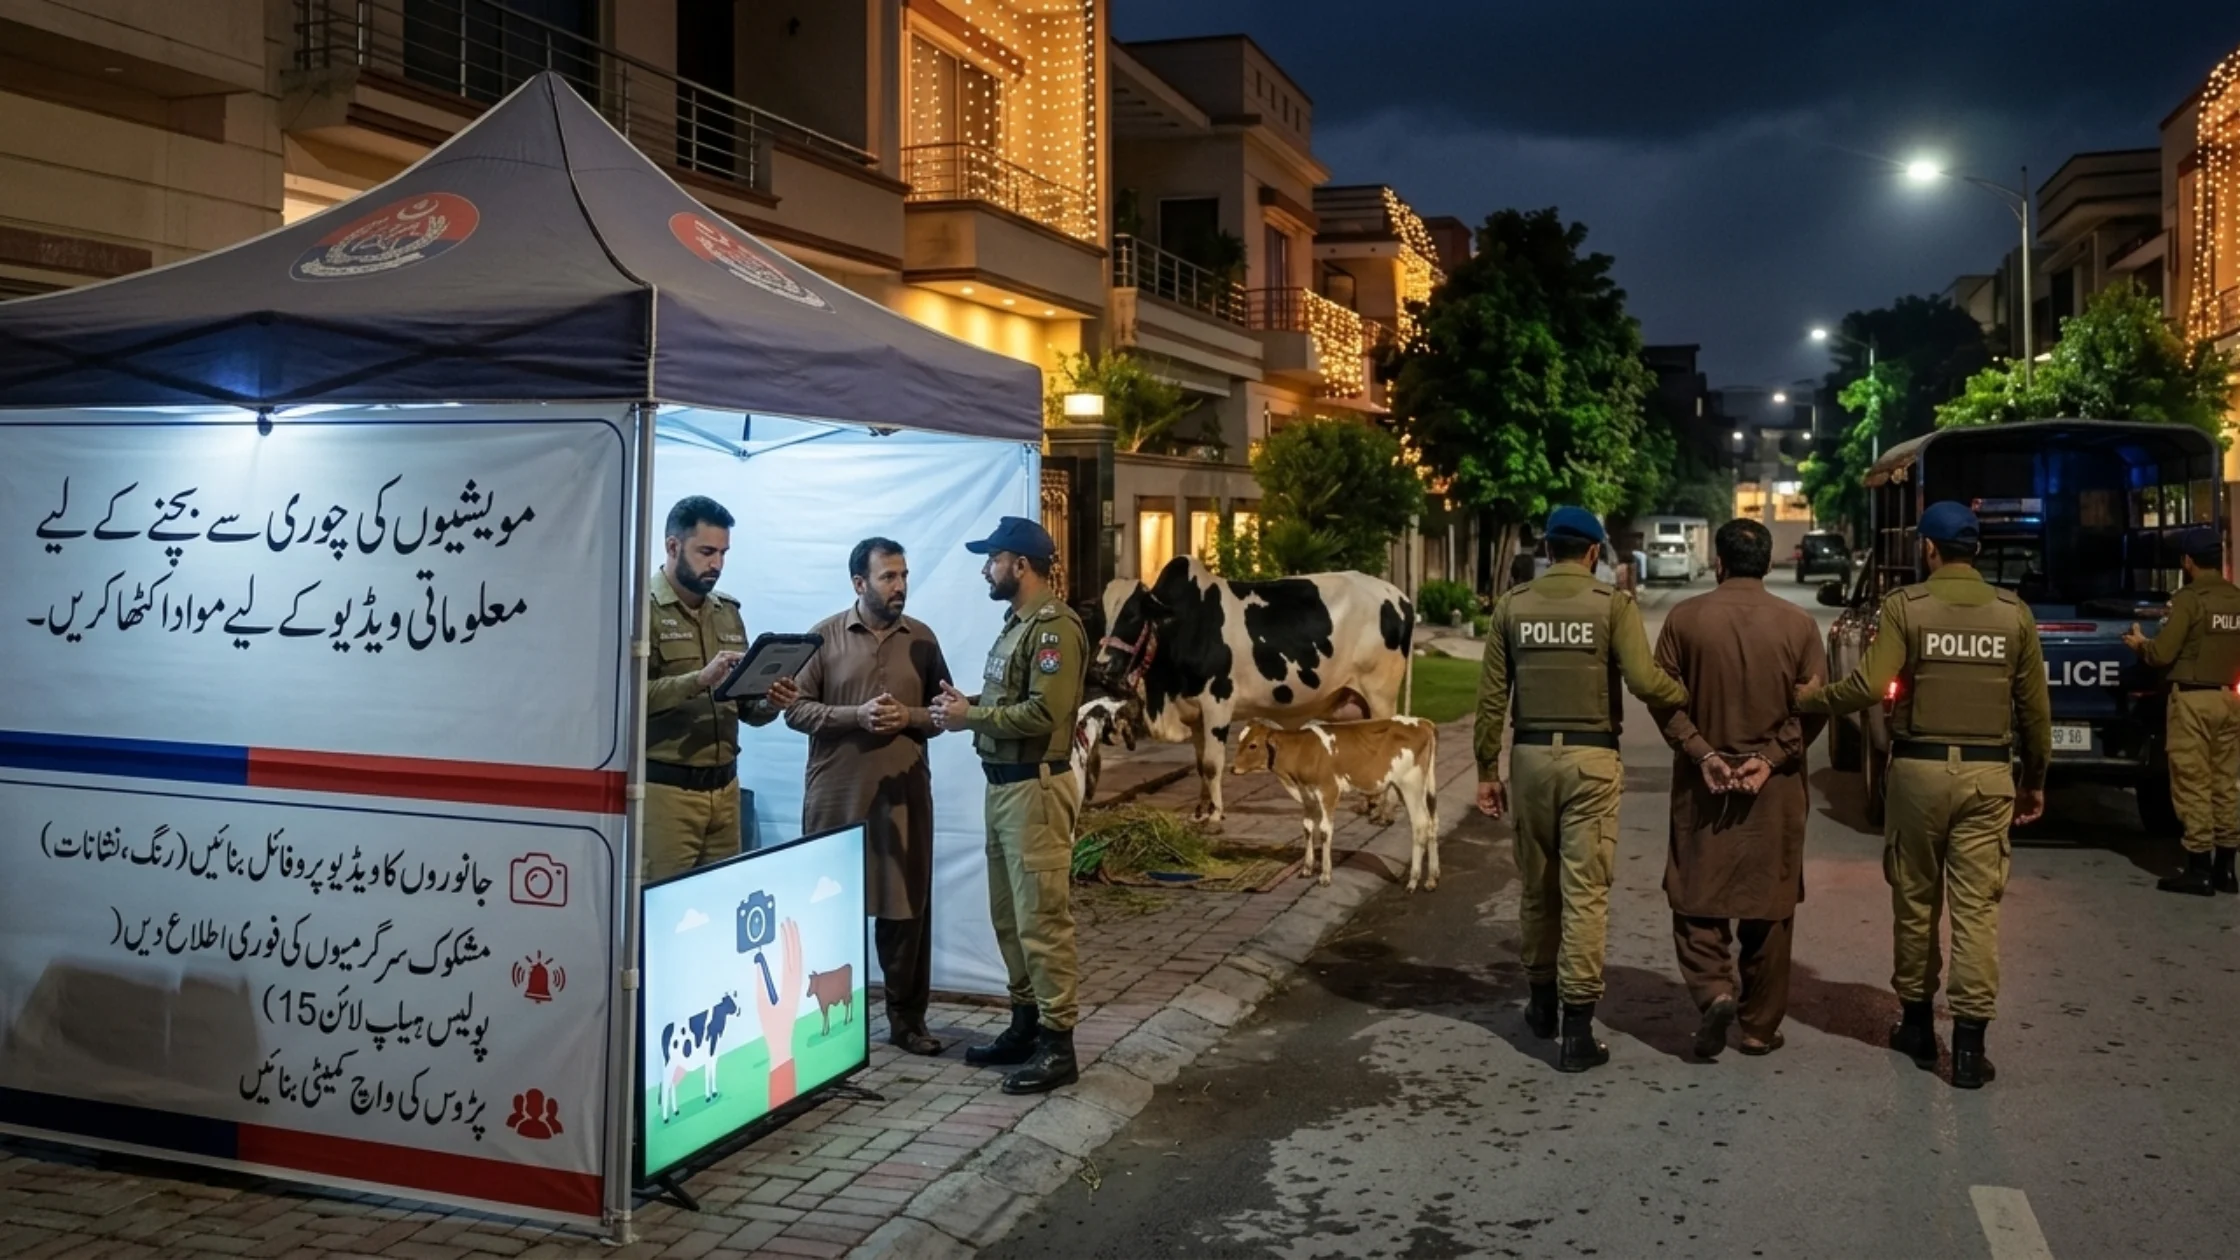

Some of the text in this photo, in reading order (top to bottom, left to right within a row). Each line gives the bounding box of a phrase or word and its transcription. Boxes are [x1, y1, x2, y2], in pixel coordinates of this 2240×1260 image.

[36, 474, 535, 566] مویشیوں کی چوری سے بچنے کے لیے
[223, 574, 274, 650] لیے
[278, 581, 327, 637] کے
[329, 586, 401, 653] ویڈیو
[407, 568, 528, 651] معلوماتی
[1520, 622, 1594, 643] POLICE
[1926, 633, 2006, 658] POLICE
[248, 827, 324, 895] پروفائل
[326, 845, 379, 893] ویڈیو
[383, 849, 405, 887] کا
[400, 852, 493, 907] جانوروں
[166, 912, 227, 955] اطلاع
[229, 914, 281, 962] فوری
[281, 912, 312, 968] کی
[408, 927, 491, 978] مشکوک
[427, 991, 490, 1064] پولیس
[301, 1049, 360, 1109] کمیٹی
[350, 1076, 394, 1115] واچ
[397, 1067, 431, 1122] کی
[423, 1089, 487, 1142] پڑوس
